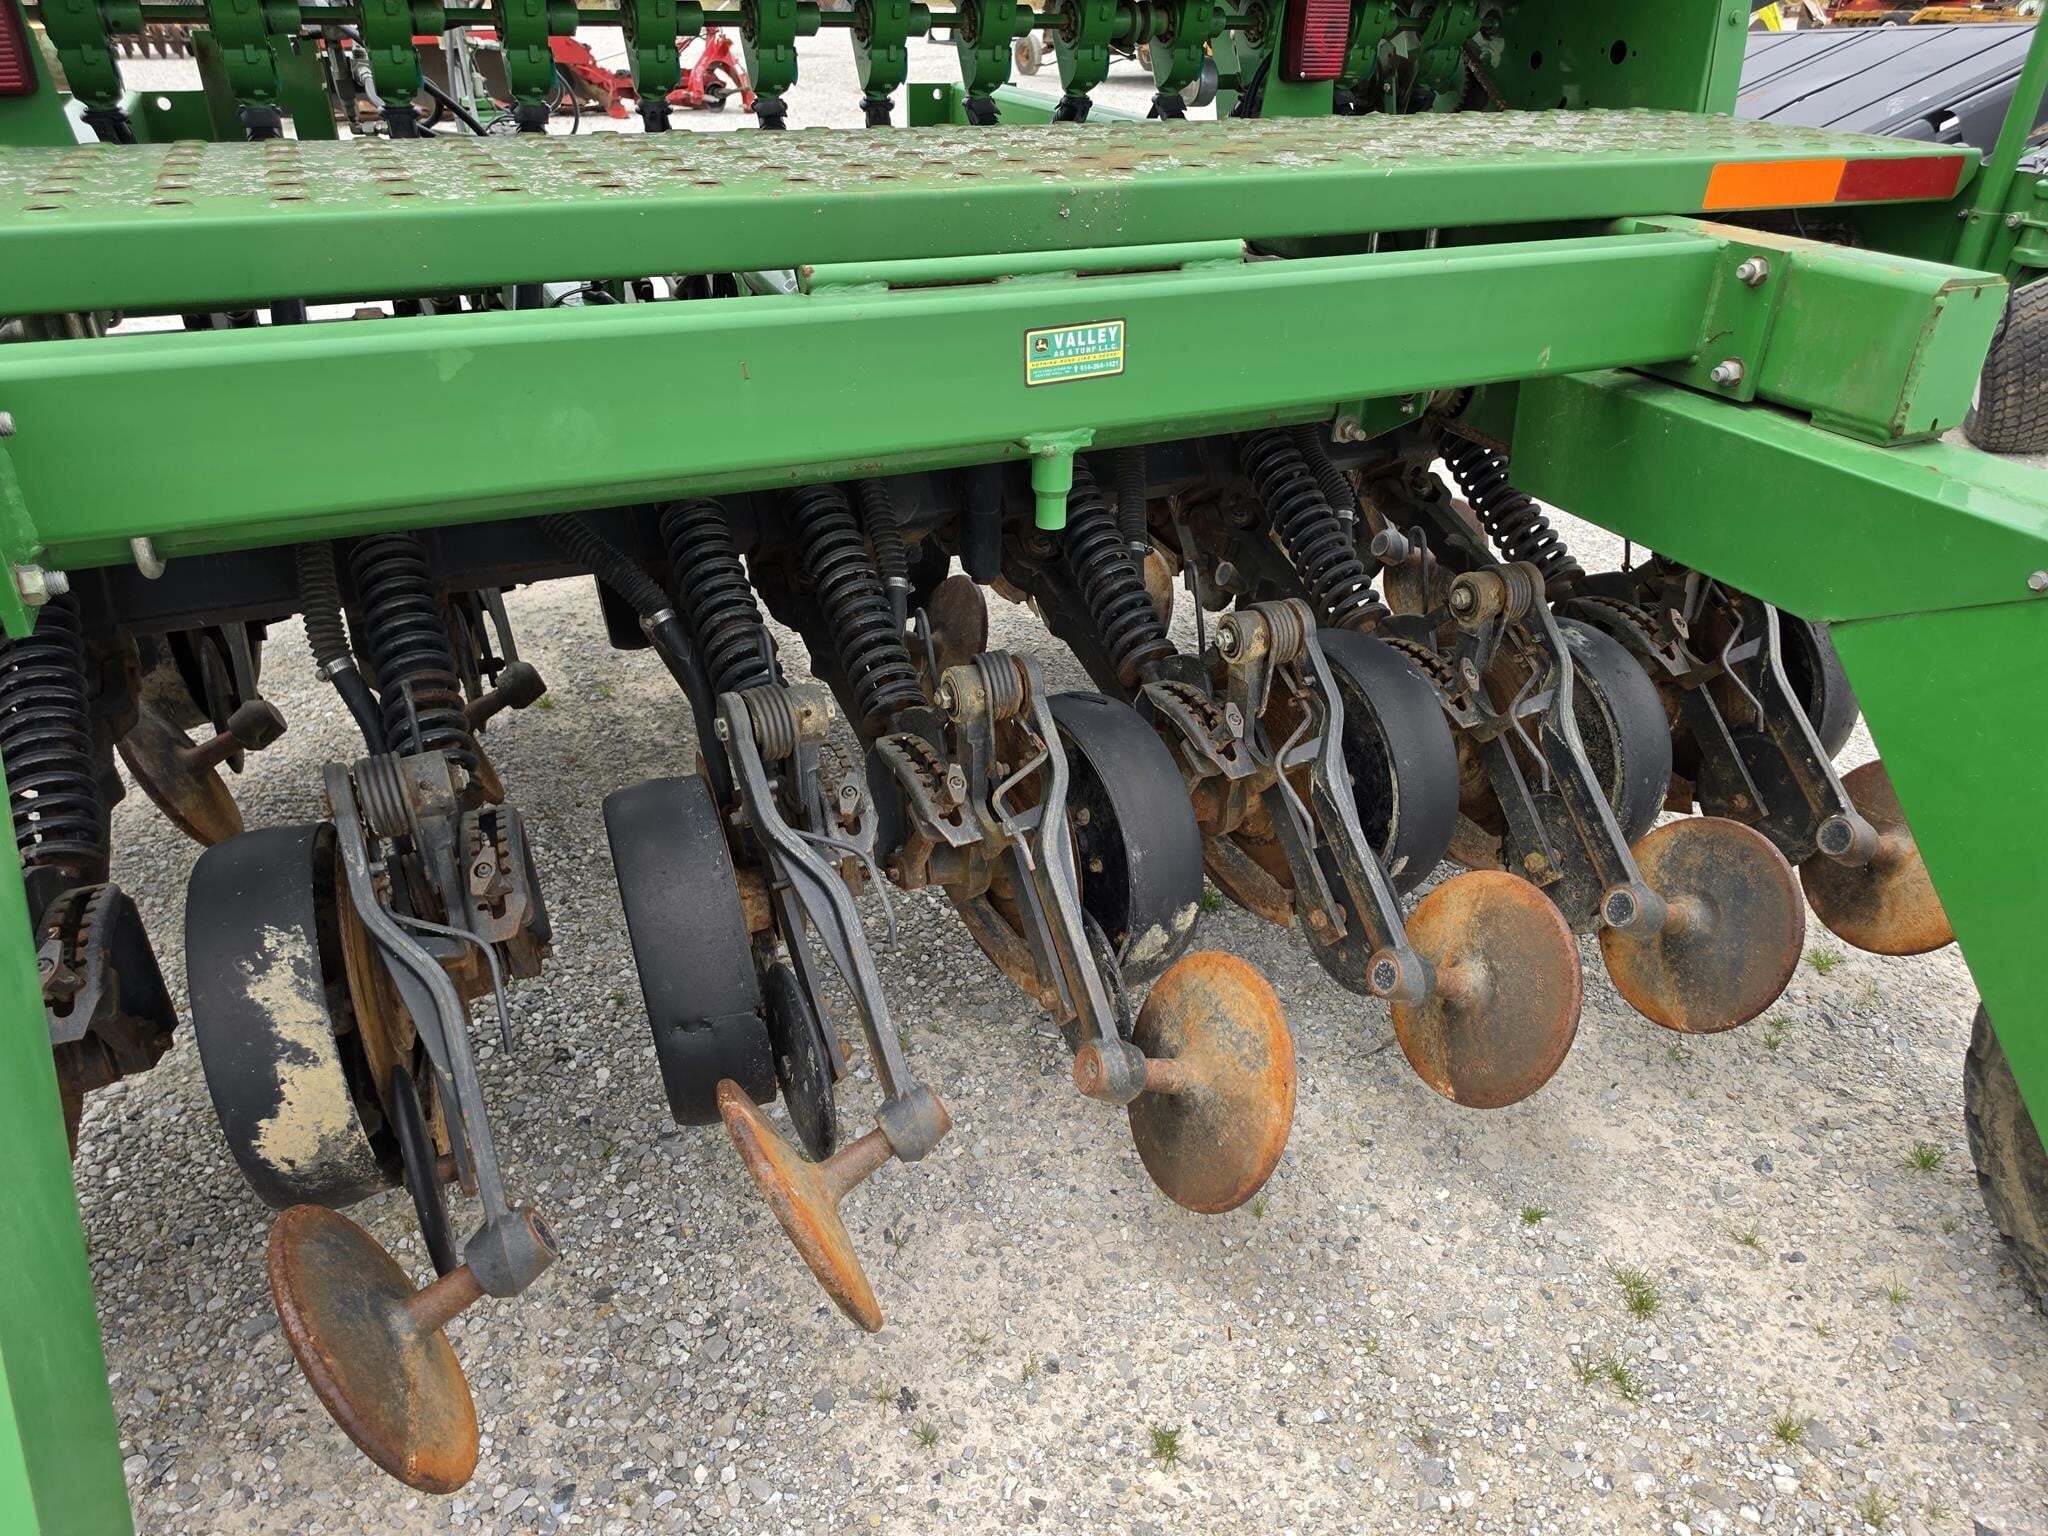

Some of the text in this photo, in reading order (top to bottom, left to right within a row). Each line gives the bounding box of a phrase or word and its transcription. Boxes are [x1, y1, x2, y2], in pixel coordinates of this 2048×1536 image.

[1053, 326, 1118, 349] VALLEY
[1054, 349, 1065, 358] AG
[1067, 348, 1073, 356] &
[1074, 345, 1096, 355] TURF
